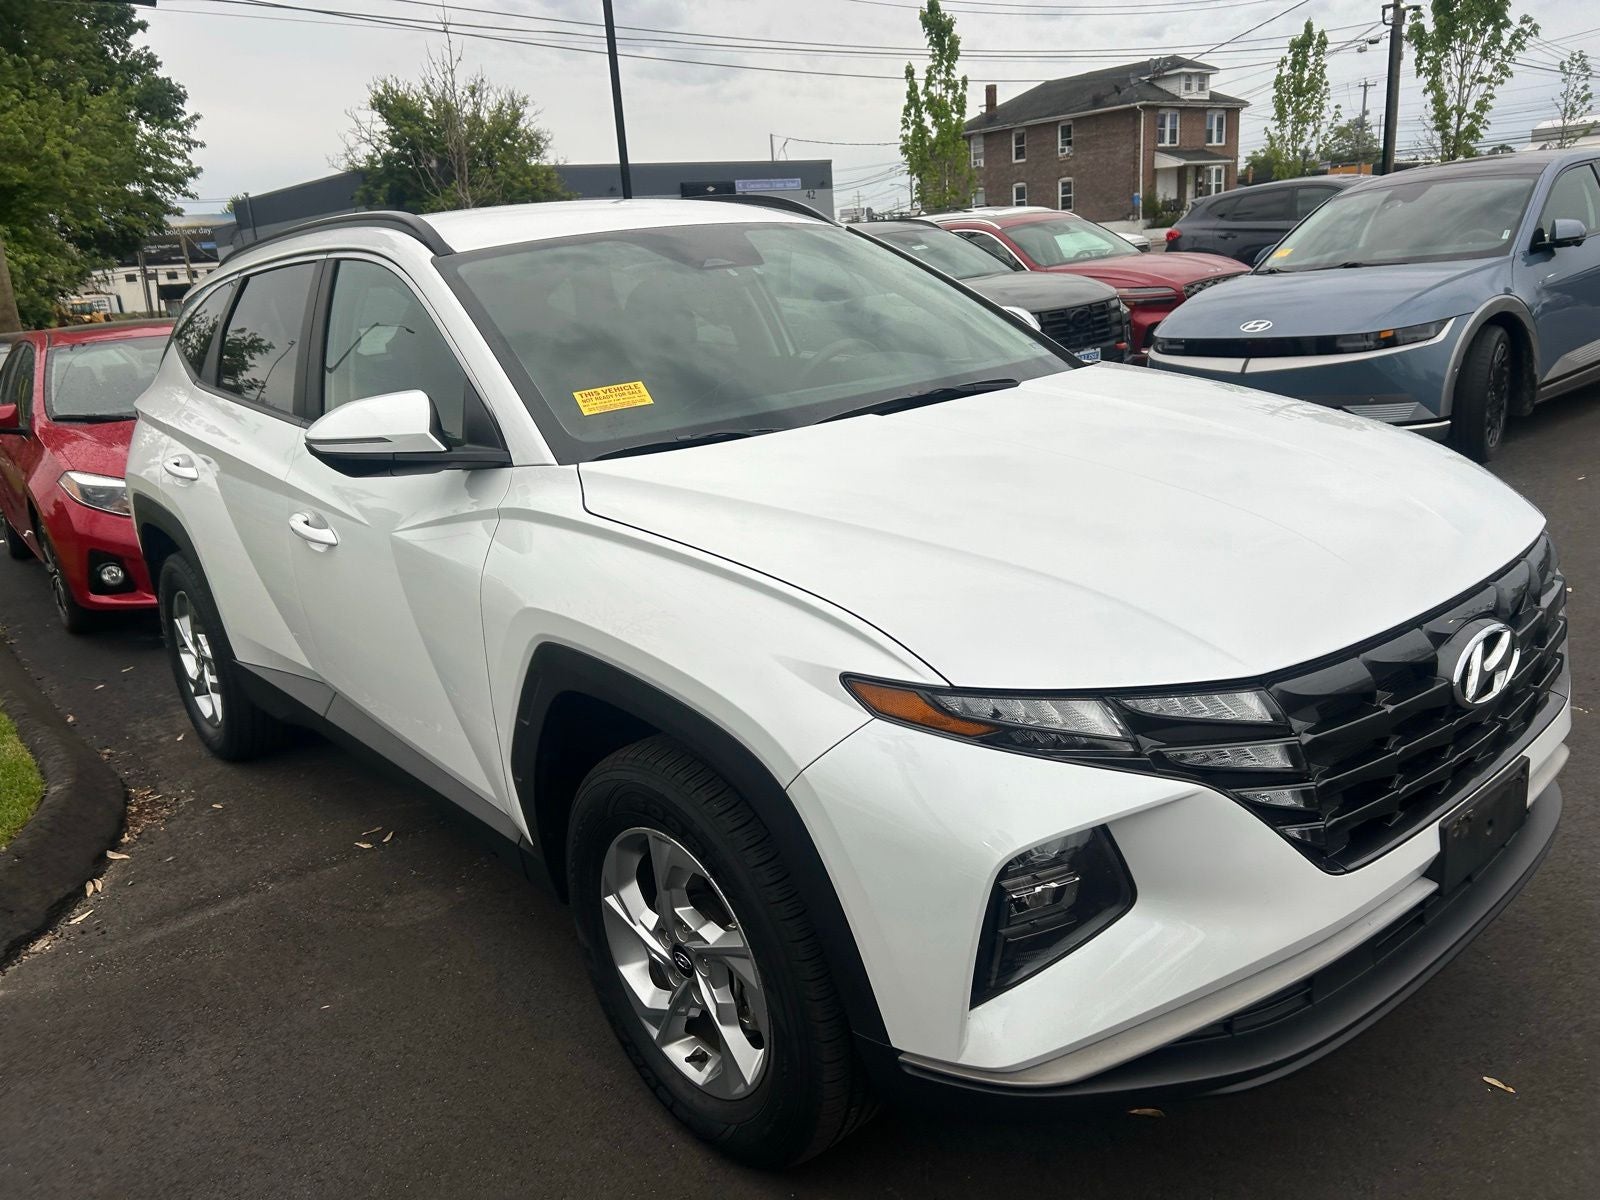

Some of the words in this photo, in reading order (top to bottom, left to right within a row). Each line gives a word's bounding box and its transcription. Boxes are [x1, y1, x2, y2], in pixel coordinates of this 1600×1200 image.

[806, 190, 816, 200] 42
[578, 391, 600, 399] THIS
[601, 384, 641, 394] VEHICLE
